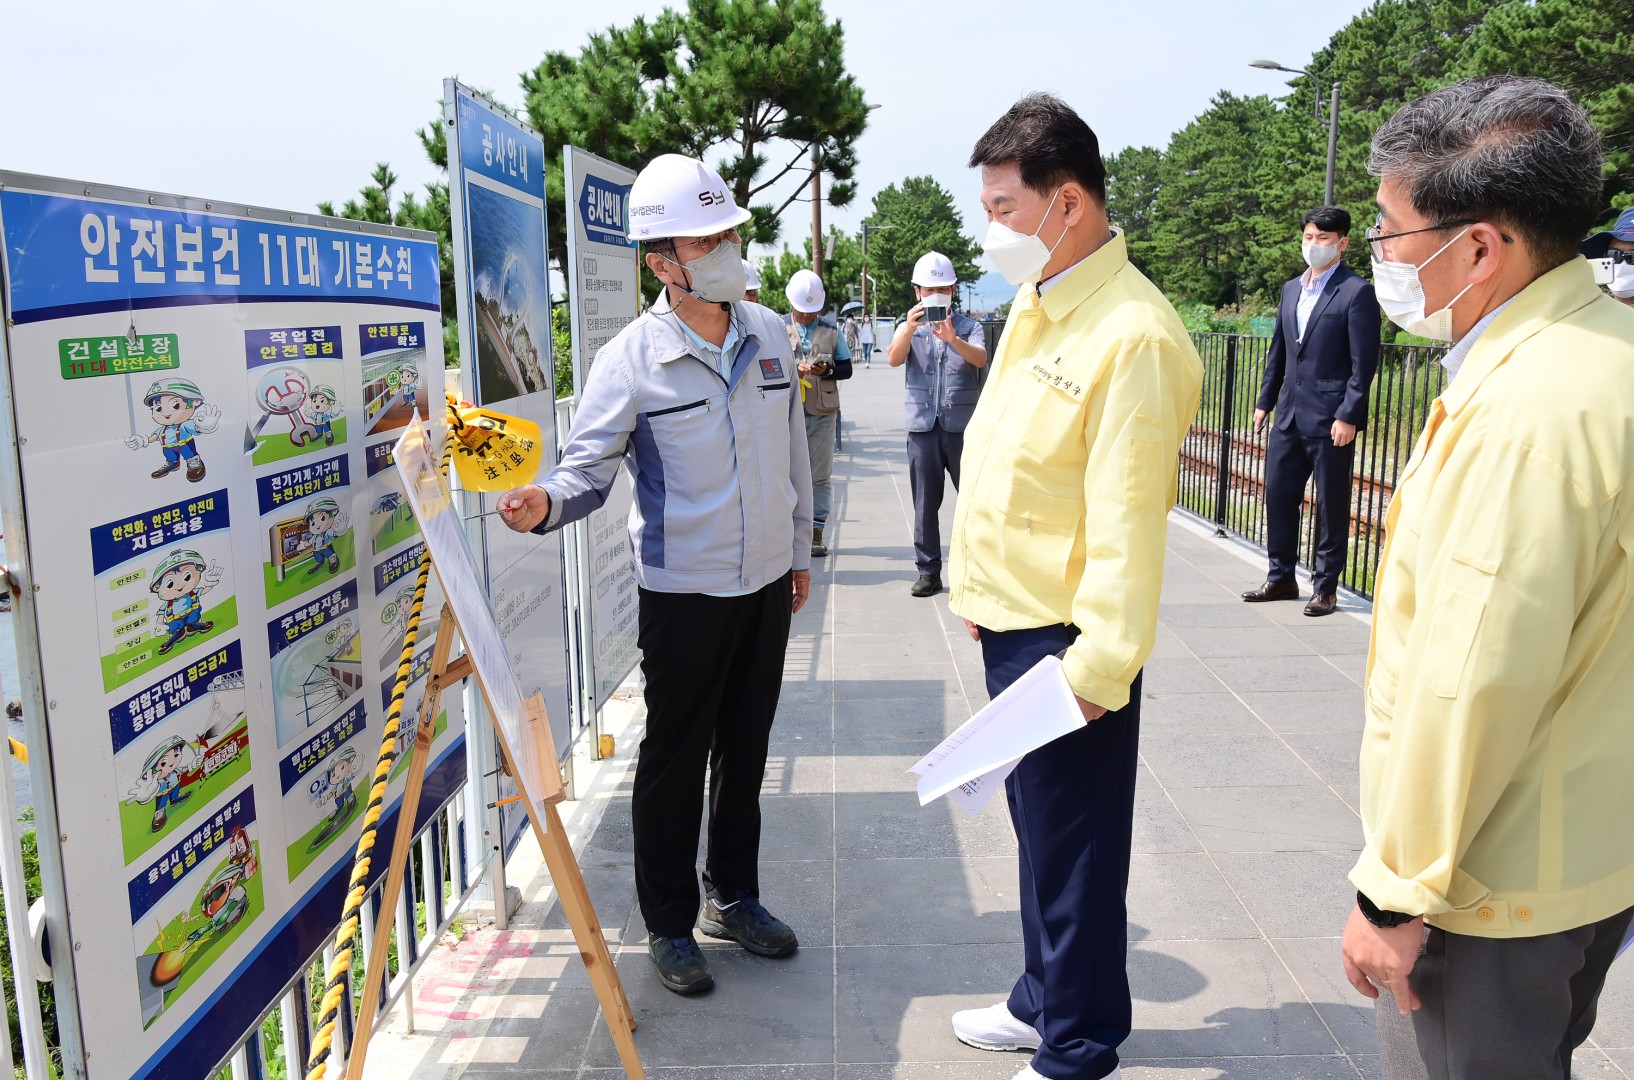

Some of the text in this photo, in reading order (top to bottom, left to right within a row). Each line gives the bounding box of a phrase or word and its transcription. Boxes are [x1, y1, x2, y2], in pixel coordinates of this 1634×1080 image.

[482, 123, 528, 183] 공사안내
[587, 185, 622, 227] 공사안내
[80, 213, 413, 291] 안전보건 11대 기본수칙
[259, 342, 334, 360] 안전점검
[367, 325, 410, 338] 안전통로
[397, 335, 418, 347] 확보
[112, 354, 173, 372] 안전수칙
[272, 472, 341, 504] 누전차단기 설치
[112, 497, 215, 542] 안전화, 안전모, 안전대
[116, 572, 140, 586] 안전모
[116, 617, 148, 635] 안전벨트
[280, 590, 342, 629] 추락방지용
[285, 597, 350, 640] 안전망 설치
[122, 653, 147, 669] 안전화
[125, 636, 142, 648] 장갑
[128, 649, 228, 717] 위험구역내 접근금지
[132, 685, 191, 732] 중량물 낙하
[291, 709, 356, 767] 밀폐공간 작업전
[297, 723, 354, 774] 산소농도 측정
[148, 850, 180, 885] 용접시
[171, 852, 197, 880] 물질
[202, 827, 225, 852] 격리
